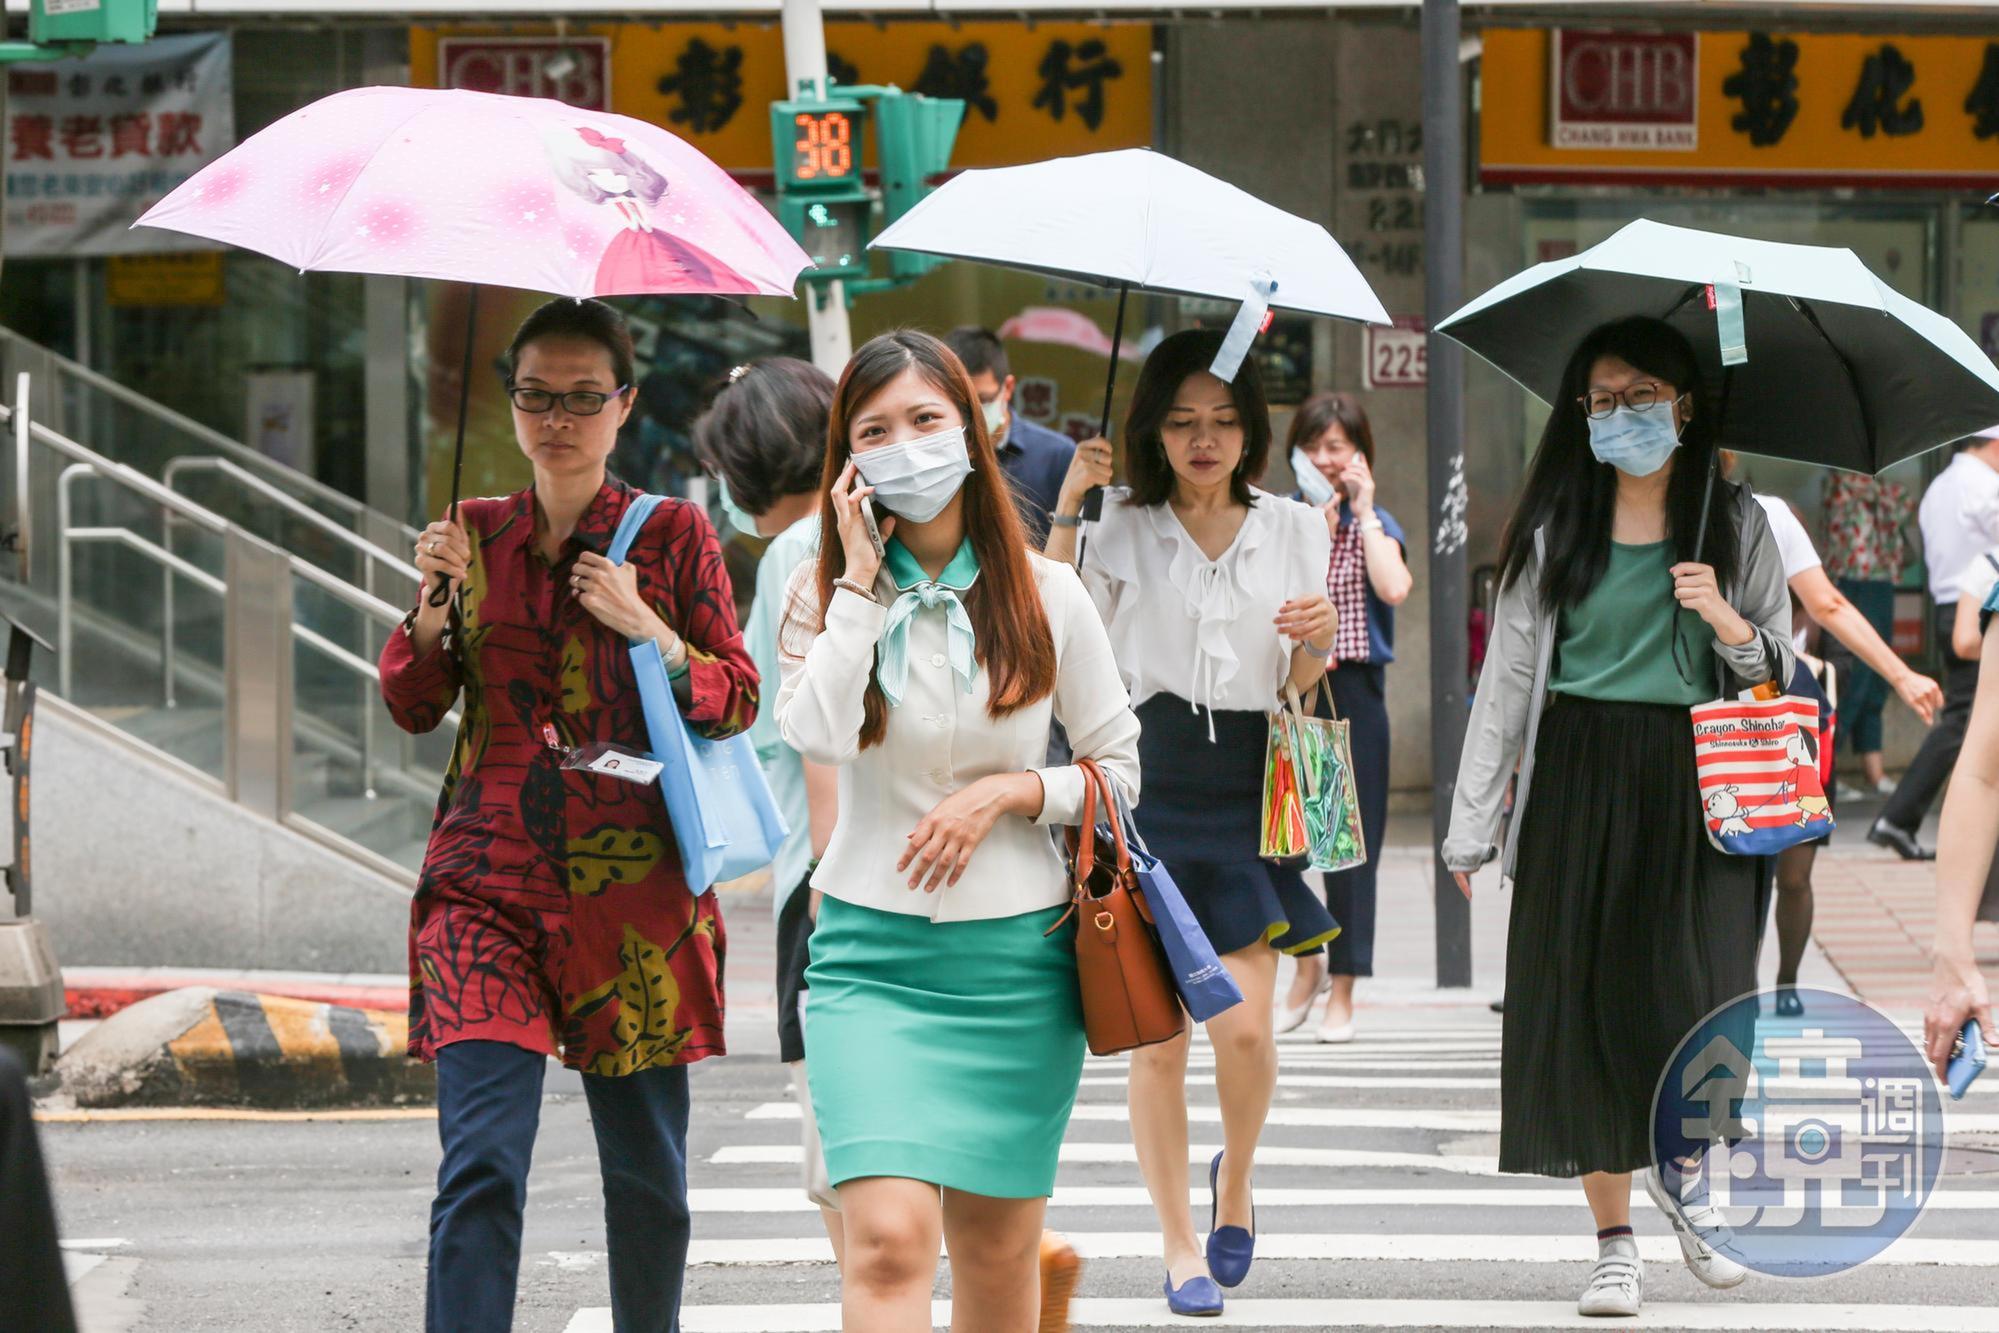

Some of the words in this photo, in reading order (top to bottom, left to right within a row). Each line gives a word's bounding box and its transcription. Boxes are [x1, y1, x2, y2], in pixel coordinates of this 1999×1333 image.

[1564, 41, 1688, 111] CHB
[795, 112, 850, 179] 38
[1559, 127, 1612, 145] CHANG
[1656, 129, 1695, 146] BANK
[1695, 723, 1736, 737] Crayon
